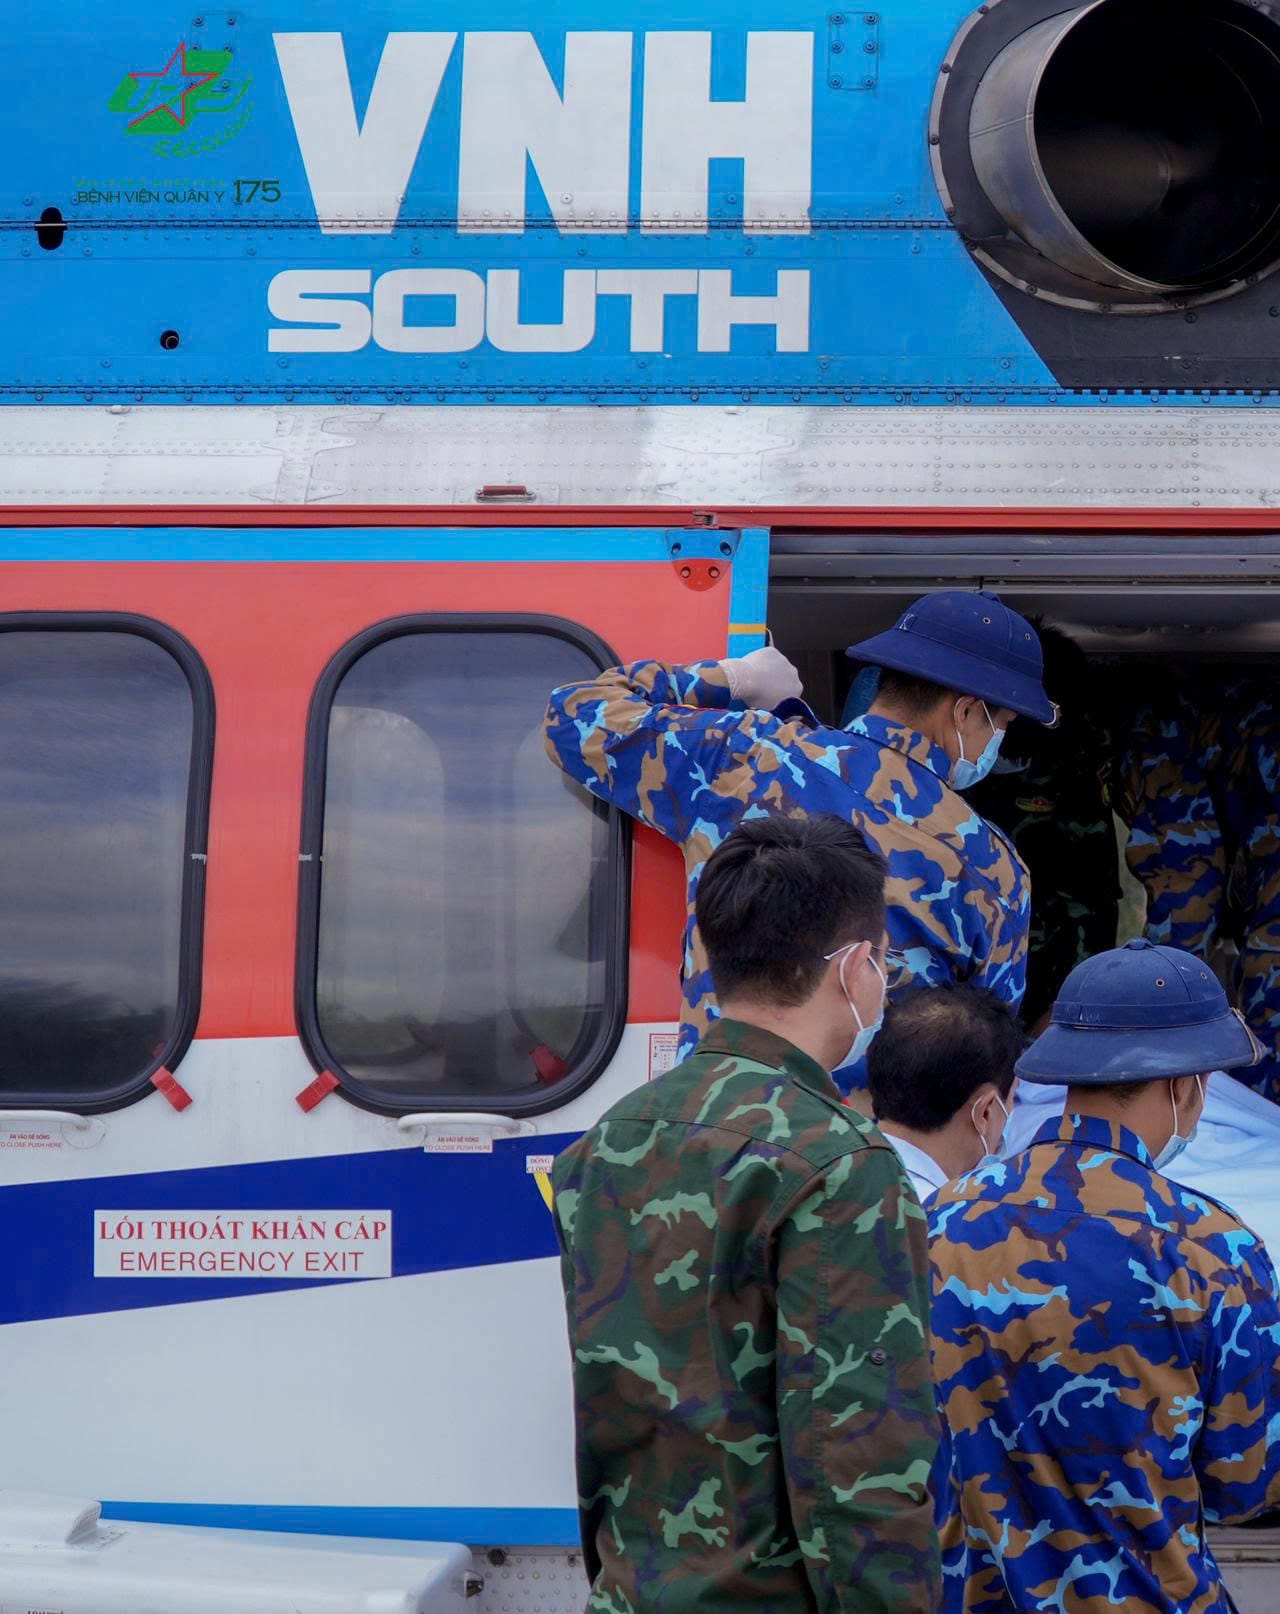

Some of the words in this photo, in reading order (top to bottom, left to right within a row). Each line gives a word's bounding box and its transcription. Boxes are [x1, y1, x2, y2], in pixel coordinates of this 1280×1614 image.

[272, 31, 814, 235] VNH
[267, 268, 810, 352] SOUTH
[99, 1215, 144, 1240] LỐI
[151, 1215, 244, 1240] THOÁT
[334, 1215, 387, 1240] CẤP
[120, 1251, 294, 1272] EMERGENCY
[304, 1251, 364, 1272] EXIT
